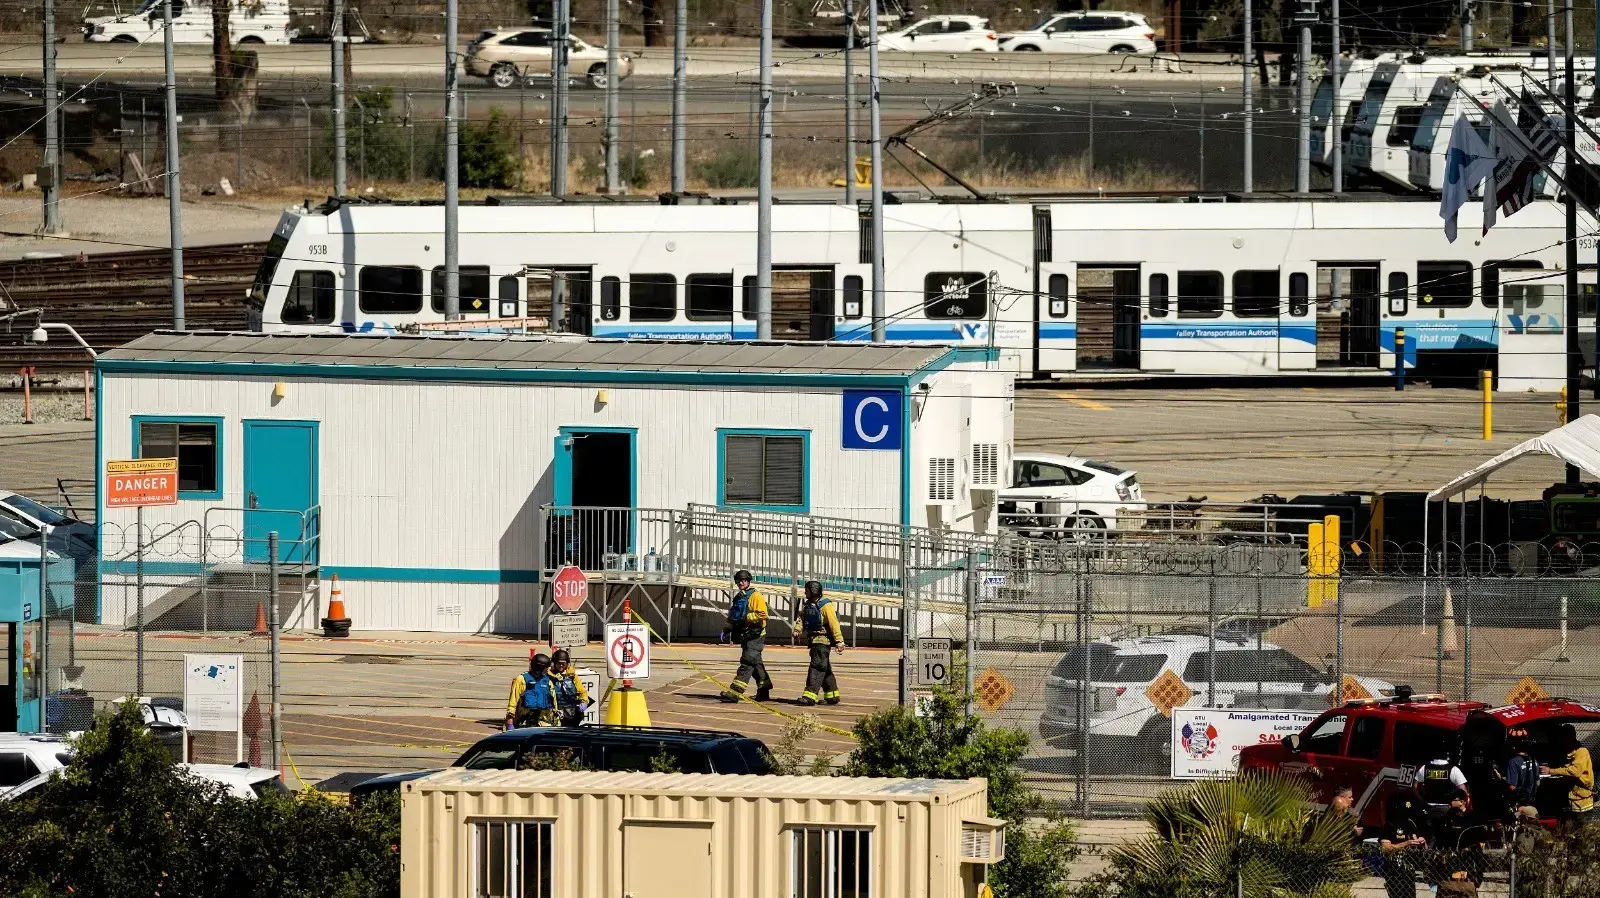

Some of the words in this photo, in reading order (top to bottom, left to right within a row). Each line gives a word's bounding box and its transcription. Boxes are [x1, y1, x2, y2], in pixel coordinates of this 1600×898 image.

[308, 244, 328, 255] 953B
[1196, 329, 1247, 337] Transportation
[1248, 329, 1279, 338] Authority
[1419, 334, 1439, 343] that
[1469, 335, 1488, 346] you
[854, 396, 889, 443] C
[115, 477, 167, 490] DANGER
[555, 580, 586, 597] STOP
[922, 642, 949, 650] SPEED
[924, 663, 946, 680] 10
[1228, 713, 1290, 722] Amalgamated
[1292, 713, 1317, 722] Trans
